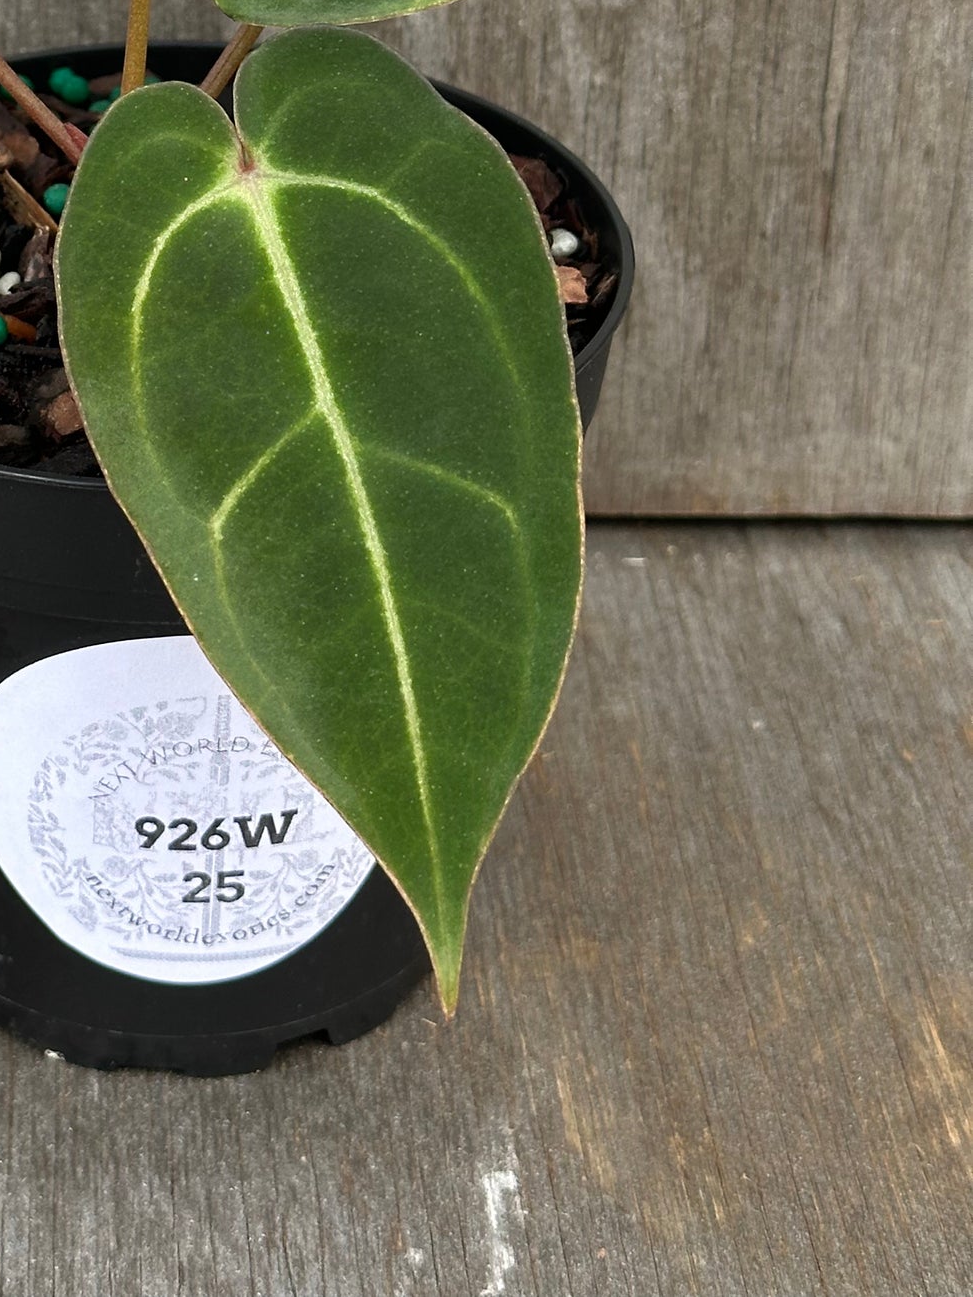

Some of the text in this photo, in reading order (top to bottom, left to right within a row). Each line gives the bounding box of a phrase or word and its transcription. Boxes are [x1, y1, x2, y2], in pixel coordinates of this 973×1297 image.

[88, 759, 138, 806] NEXT
[140, 736, 250, 765] WORLD
[135, 808, 299, 851] 926W
[85, 864, 337, 947] nextworldexotics.com
[181, 869, 247, 904] 25
